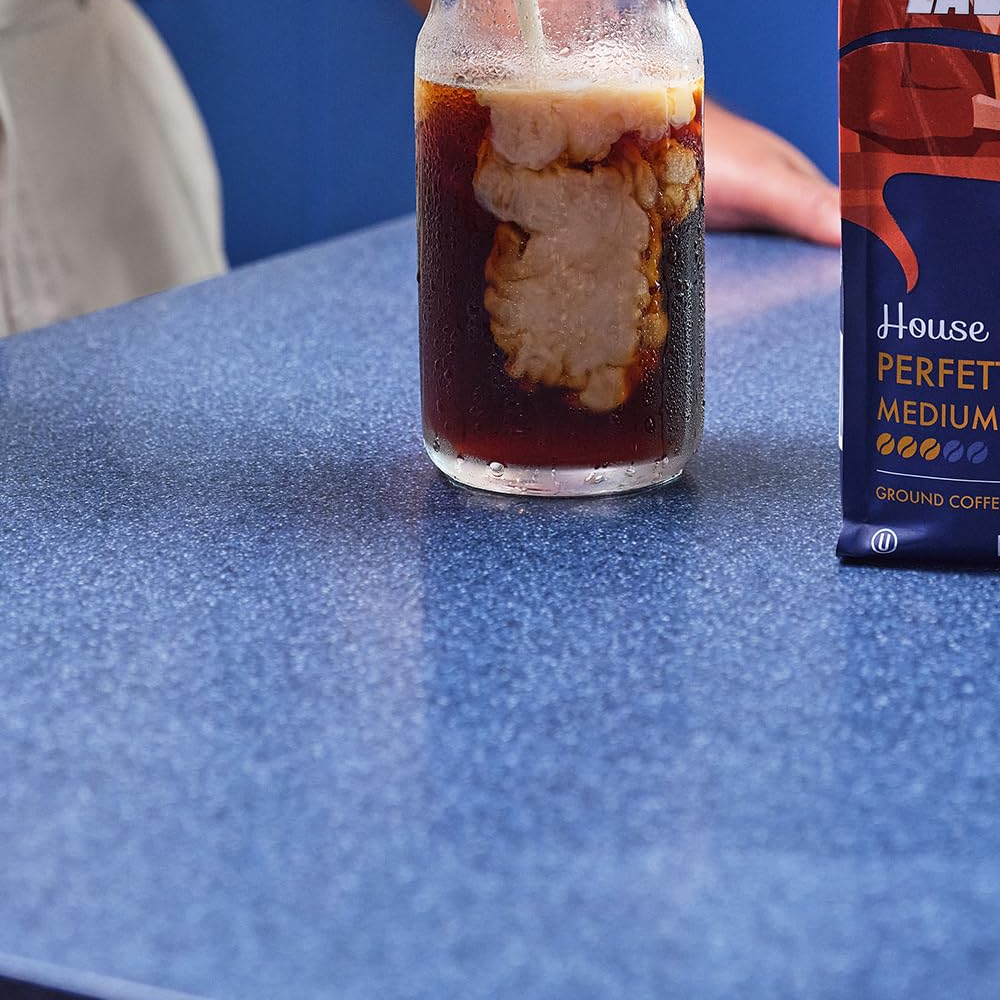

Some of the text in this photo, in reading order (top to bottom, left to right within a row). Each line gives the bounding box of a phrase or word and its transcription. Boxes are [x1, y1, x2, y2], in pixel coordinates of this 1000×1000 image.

[877, 302, 989, 342] House
[877, 396, 999, 431] MEDIUM
[875, 486, 944, 508] GROUND
